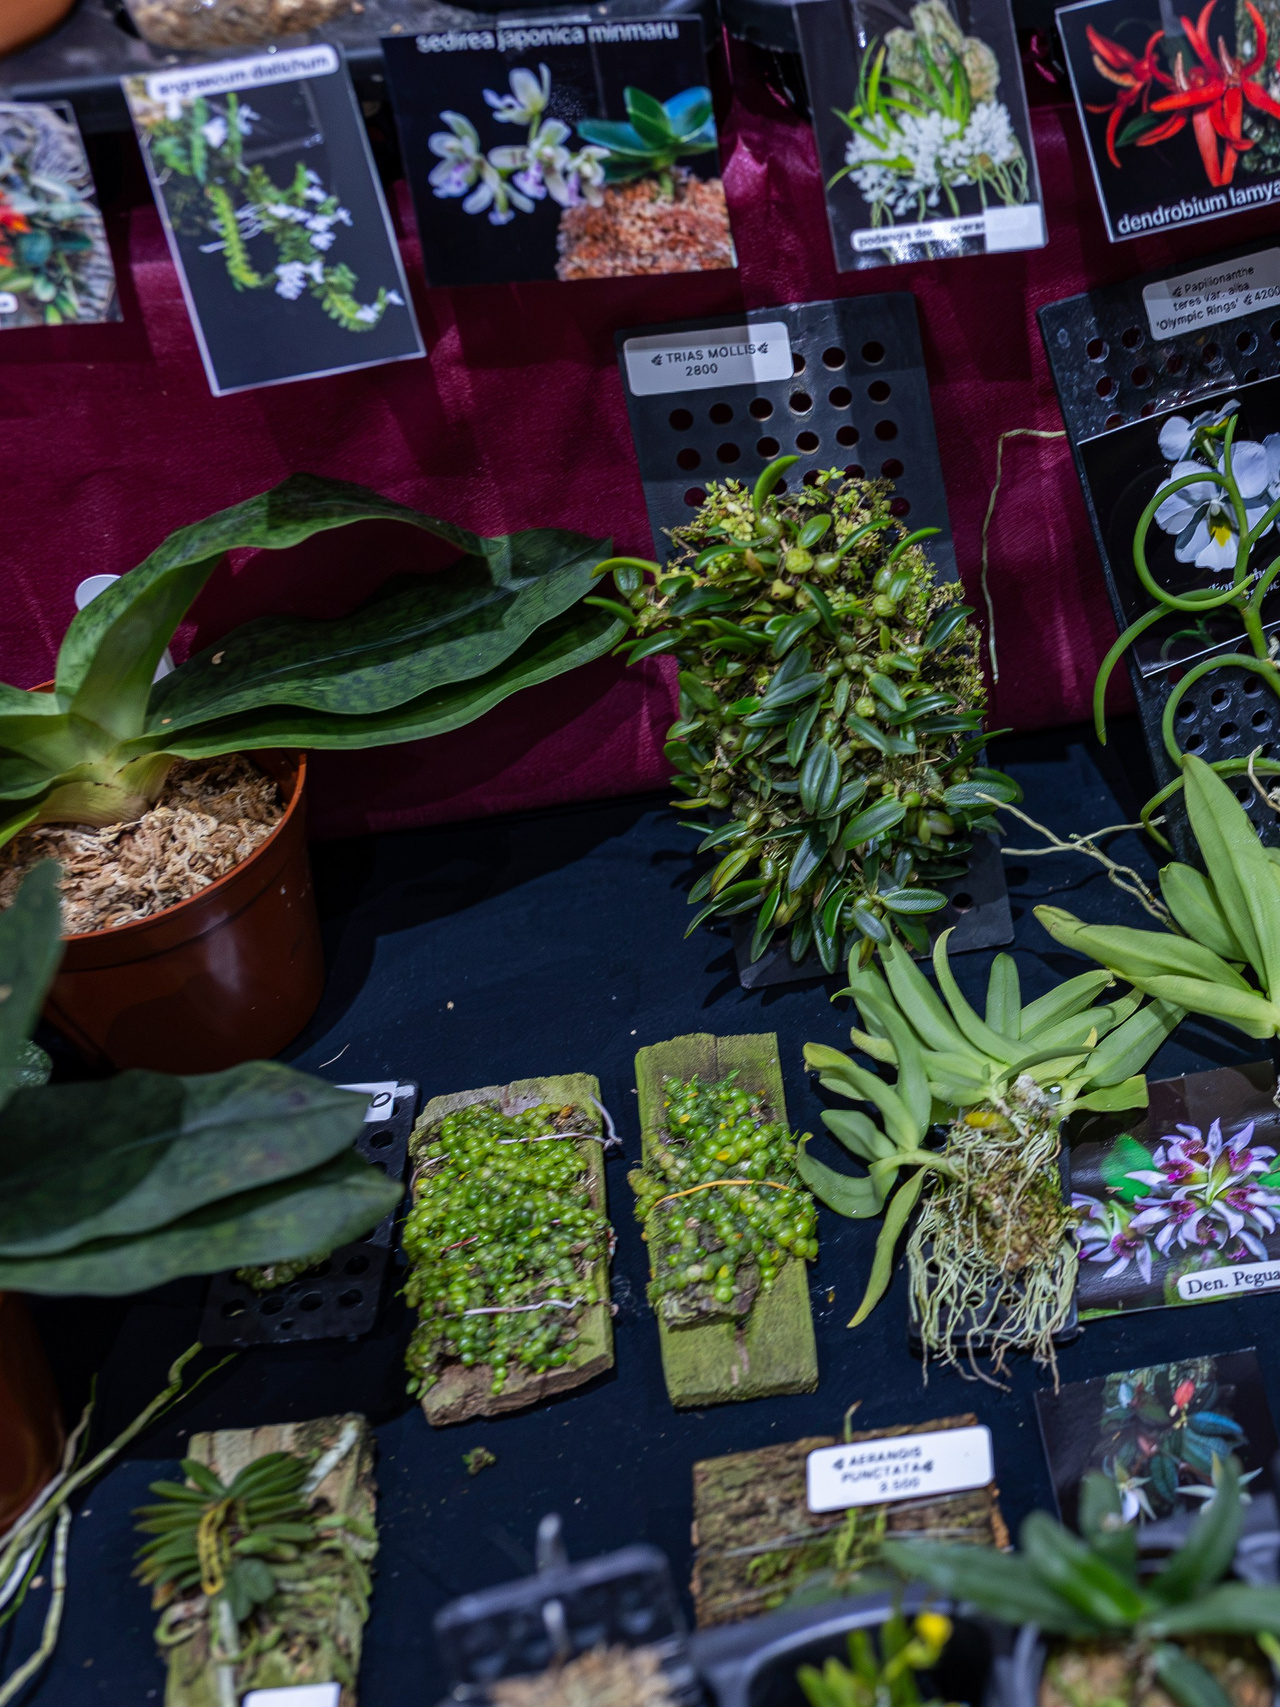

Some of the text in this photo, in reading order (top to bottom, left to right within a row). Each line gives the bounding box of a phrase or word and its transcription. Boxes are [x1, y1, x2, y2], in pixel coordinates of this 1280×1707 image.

[415, 30, 495, 54] sedirea
[496, 25, 587, 53] japonica
[1117, 193, 1228, 235] dendrobium
[1184, 265, 1255, 294] Papilionanthe
[1172, 296, 1202, 312] teres
[665, 343, 756, 364] TRIAS MOLLIS
[685, 362, 718, 377] 2800
[1186, 1279, 1229, 1296] Den.
[841, 1463, 922, 1483] PUNCTATA
